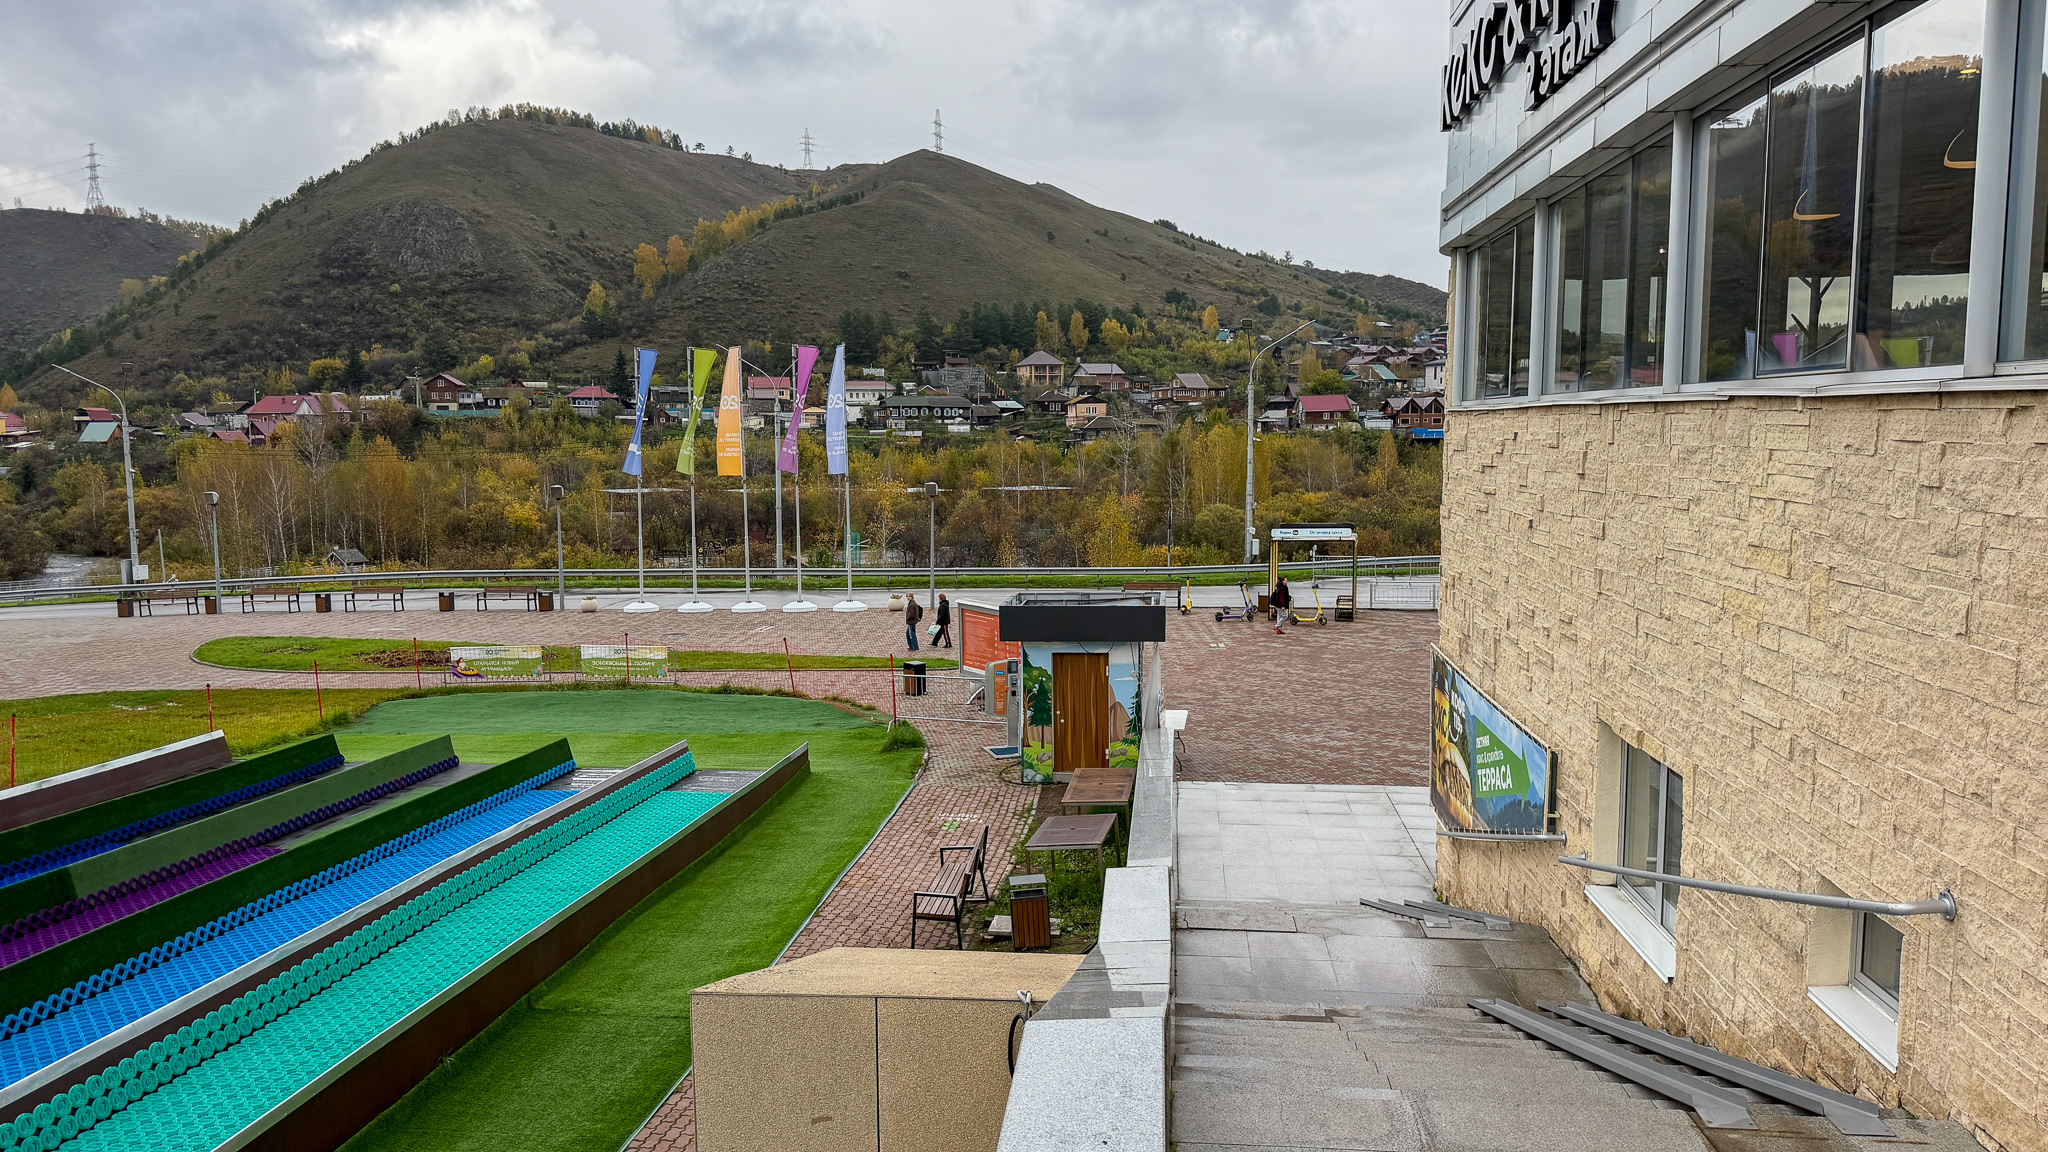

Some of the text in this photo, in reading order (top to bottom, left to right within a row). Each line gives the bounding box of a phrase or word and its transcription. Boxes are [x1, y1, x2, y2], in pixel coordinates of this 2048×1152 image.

[1524, 50, 1536, 112] 2
[1539, 0, 1601, 95] этаж
[1477, 764, 1513, 792] ТЕРРАСА
